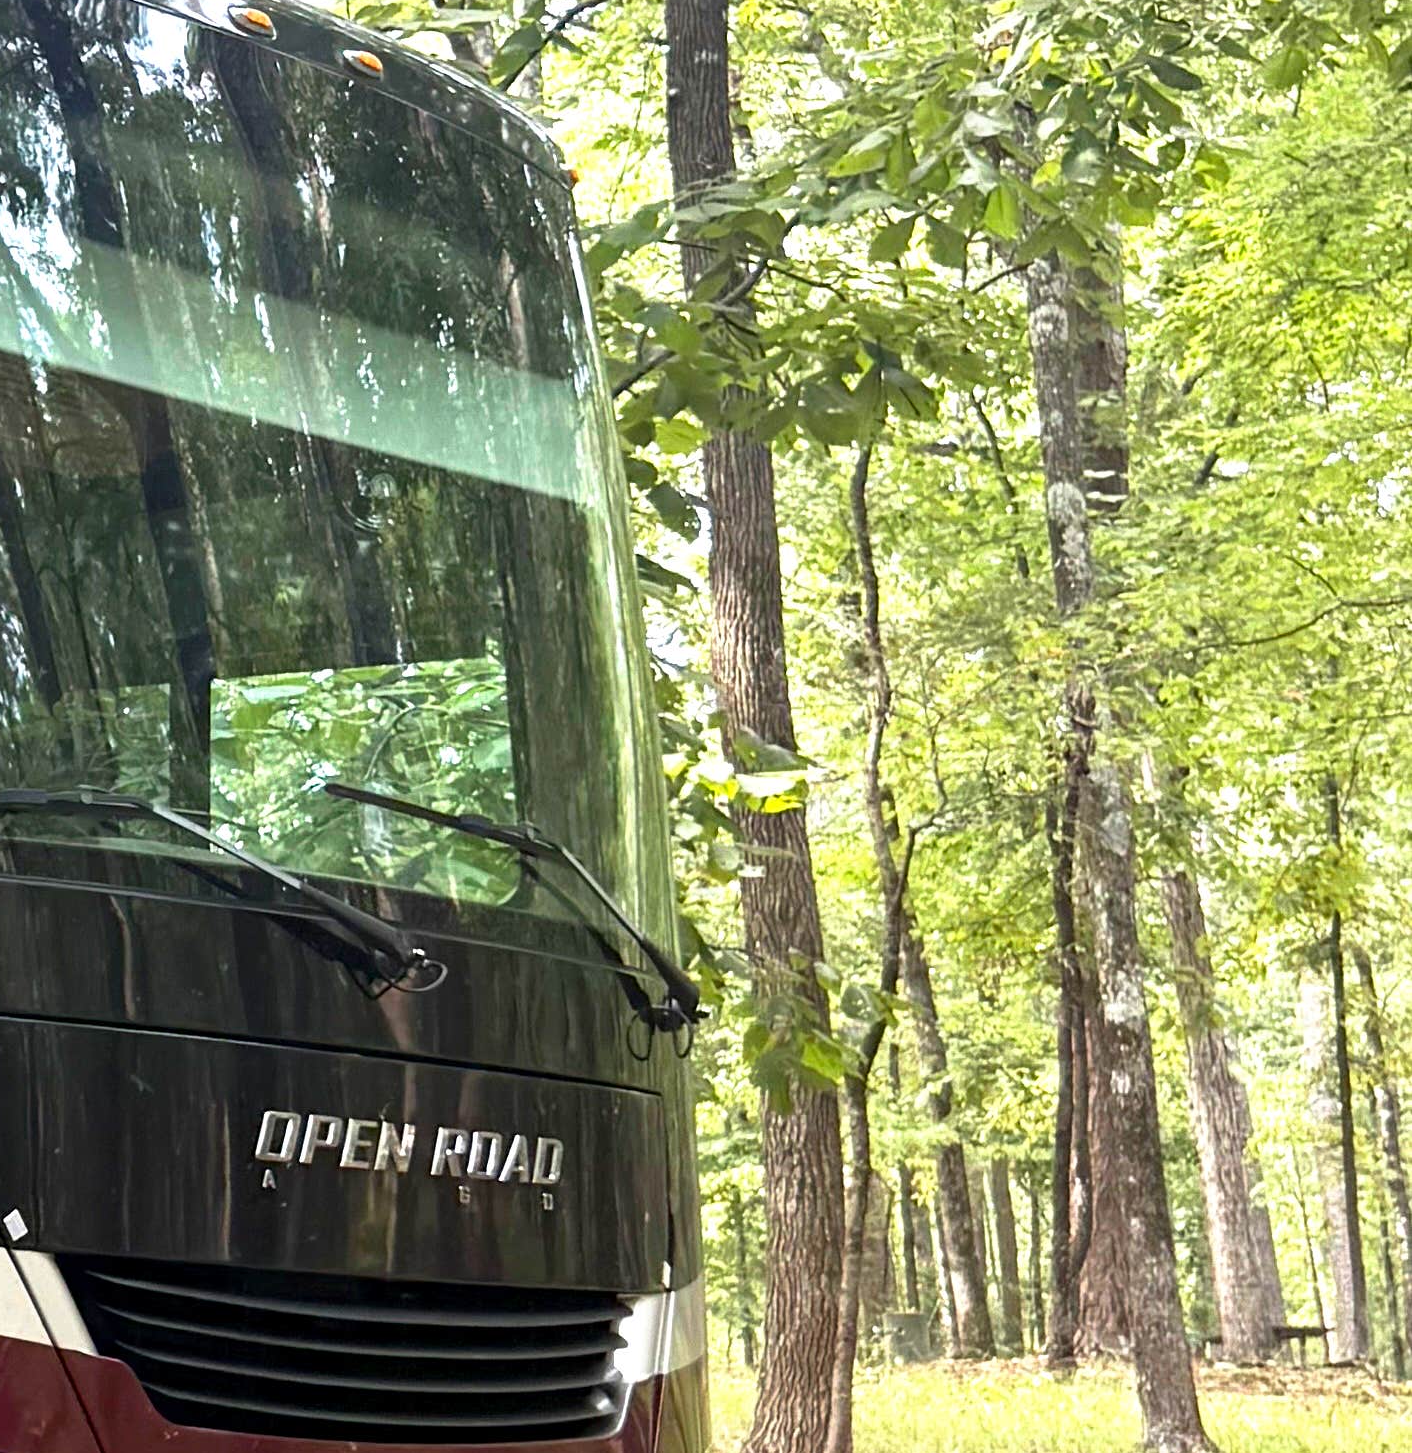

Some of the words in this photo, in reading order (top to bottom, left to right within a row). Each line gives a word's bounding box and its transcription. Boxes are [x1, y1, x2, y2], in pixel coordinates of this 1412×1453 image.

[255, 1111, 415, 1173] OPEN
[431, 1127, 563, 1184] ROAD
[262, 1168, 276, 1189] A
